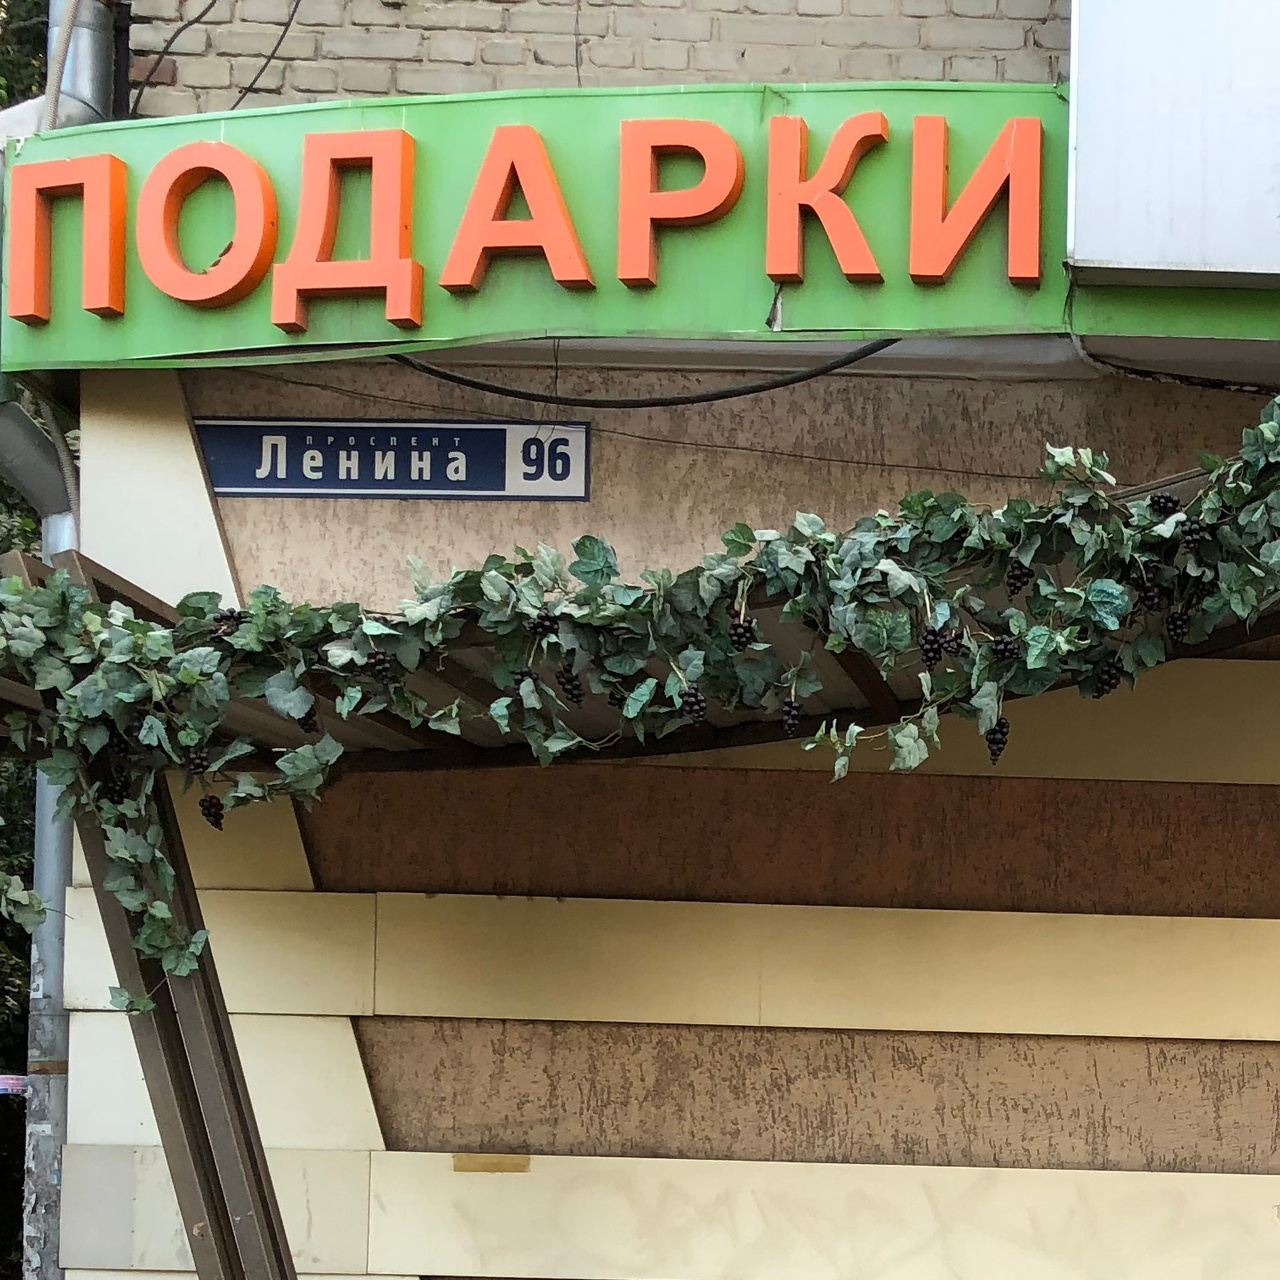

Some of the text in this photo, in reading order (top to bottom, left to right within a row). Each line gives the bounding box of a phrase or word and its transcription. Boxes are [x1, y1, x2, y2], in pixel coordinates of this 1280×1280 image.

[6, 110, 1043, 332] ПОДАРКИ
[255, 435, 572, 482] Ленина 96
